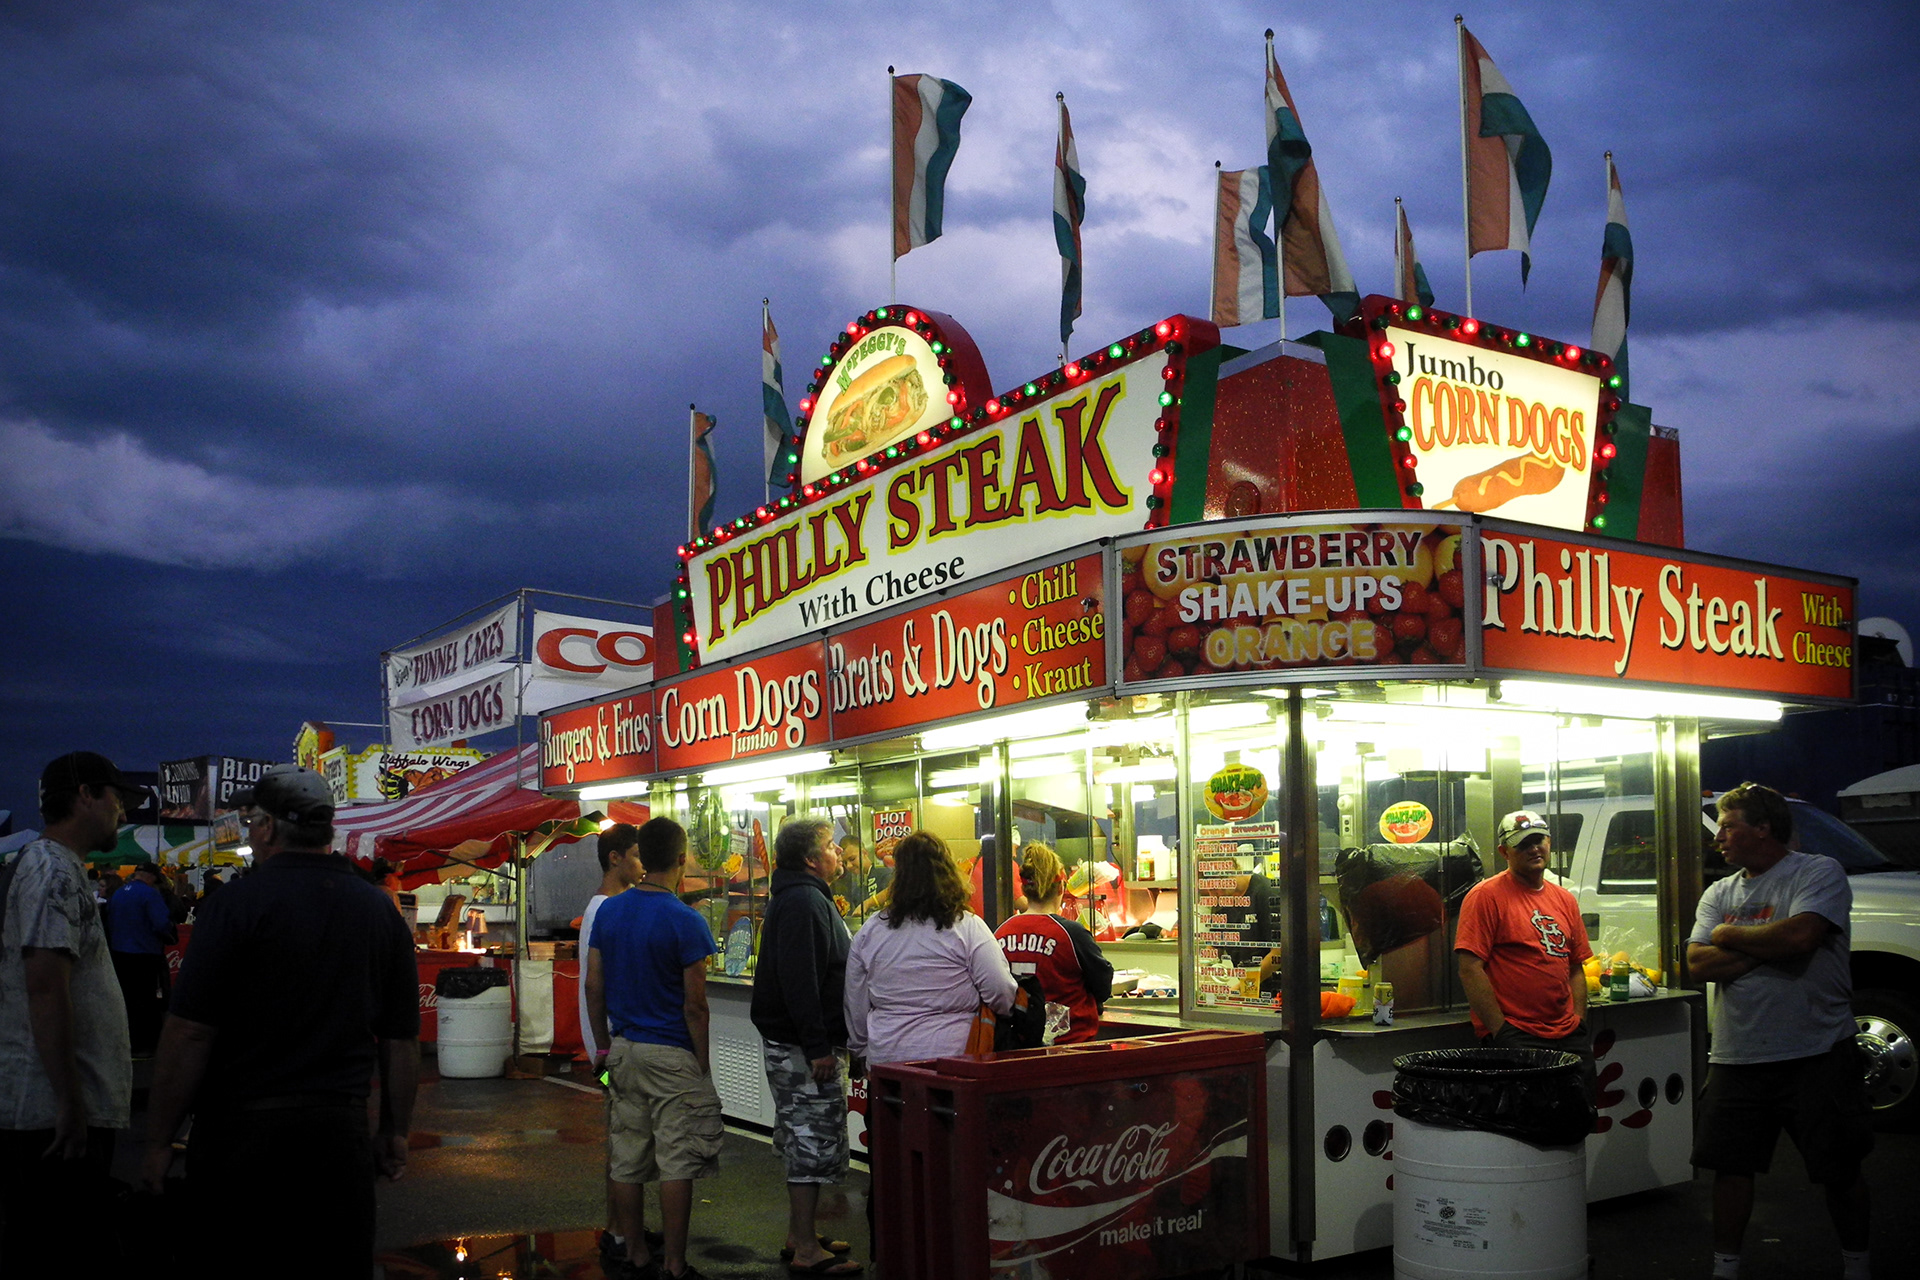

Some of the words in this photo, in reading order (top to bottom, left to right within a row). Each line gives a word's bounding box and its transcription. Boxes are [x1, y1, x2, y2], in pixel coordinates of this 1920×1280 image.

[1405, 341, 1504, 391] Jumbo
[1412, 377, 1502, 452] CORN
[1507, 396, 1588, 472] DOGS
[705, 491, 873, 649] PHILLY
[887, 377, 1132, 552] STEAK
[1157, 531, 1422, 584] STRAWBERRY
[799, 587, 858, 629] With
[866, 555, 965, 600] Cheese
[1020, 560, 1078, 610] Chili
[1178, 575, 1403, 624] SHAKE-UPS
[1482, 538, 1642, 676] Philly
[1658, 564, 1784, 660] Steak
[1022, 611, 1105, 656] Cheese
[1801, 592, 1844, 628] With
[463, 618, 505, 668] CAKES
[829, 642, 894, 714] Brats
[901, 620, 927, 695] &
[931, 610, 1009, 710] Dogs
[1205, 619, 1377, 667] ORANGE
[1792, 631, 1852, 669] Cheese
[1026, 656, 1092, 700] Kraut
[412, 700, 453, 743] CORN
[459, 681, 503, 732] DOGS
[661, 687, 730, 749] Corn
[735, 666, 820, 750] Dogs
[380, 752, 428, 768] Buffalo
[432, 755, 470, 768] Wings
[542, 719, 593, 784] Burgers
[596, 707, 611, 766] &
[613, 701, 651, 757] Fries
[730, 729, 779, 760] Jumbo
[1210, 773, 1262, 793] SHAKE-UPS
[875, 825, 912, 843] DOGS
[880, 811, 906, 826] HOT
[1200, 828, 1230, 837] Orange
[1199, 879, 1237, 889] HAMBURGERS
[1235, 896, 1251, 907] DOGS
[998, 933, 1057, 956] PUJOLS
[1029, 1121, 1181, 1195] Coca-Cola
[1100, 1221, 1153, 1247] make
[1167, 1209, 1204, 1234] real
